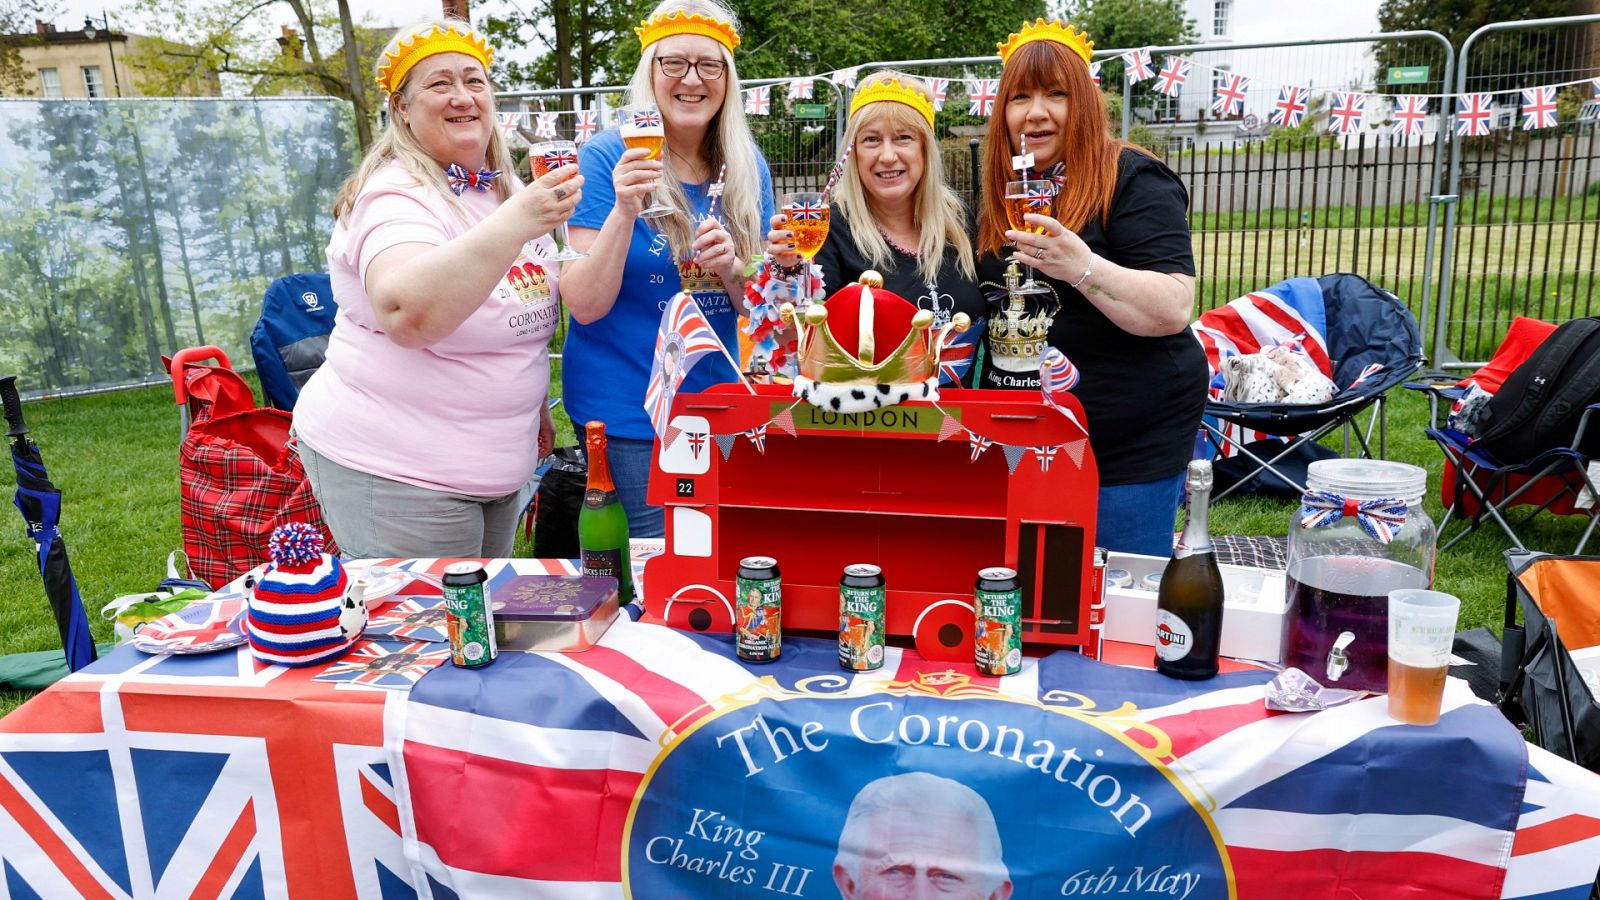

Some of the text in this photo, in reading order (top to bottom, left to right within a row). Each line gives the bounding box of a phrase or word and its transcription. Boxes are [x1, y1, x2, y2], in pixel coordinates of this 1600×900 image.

[649, 234, 669, 256] KIN
[649, 274, 664, 284] 20
[500, 288, 511, 299] 20
[508, 303, 560, 329] CORONATIO
[988, 370, 1041, 388] King Charles
[811, 407, 918, 428] LONDON
[678, 482, 693, 493] 22
[599, 568, 613, 576] FIZZ
[763, 591, 781, 604] KIN
[991, 599, 1008, 607] THE
[846, 601, 878, 613] KING
[983, 605, 1015, 617] KING
[1157, 624, 1185, 645] ARTINI
[716, 701, 1152, 838] The Coronation
[685, 808, 766, 860] King
[645, 836, 814, 897] Charles III
[1061, 865, 1200, 900] 6th May
